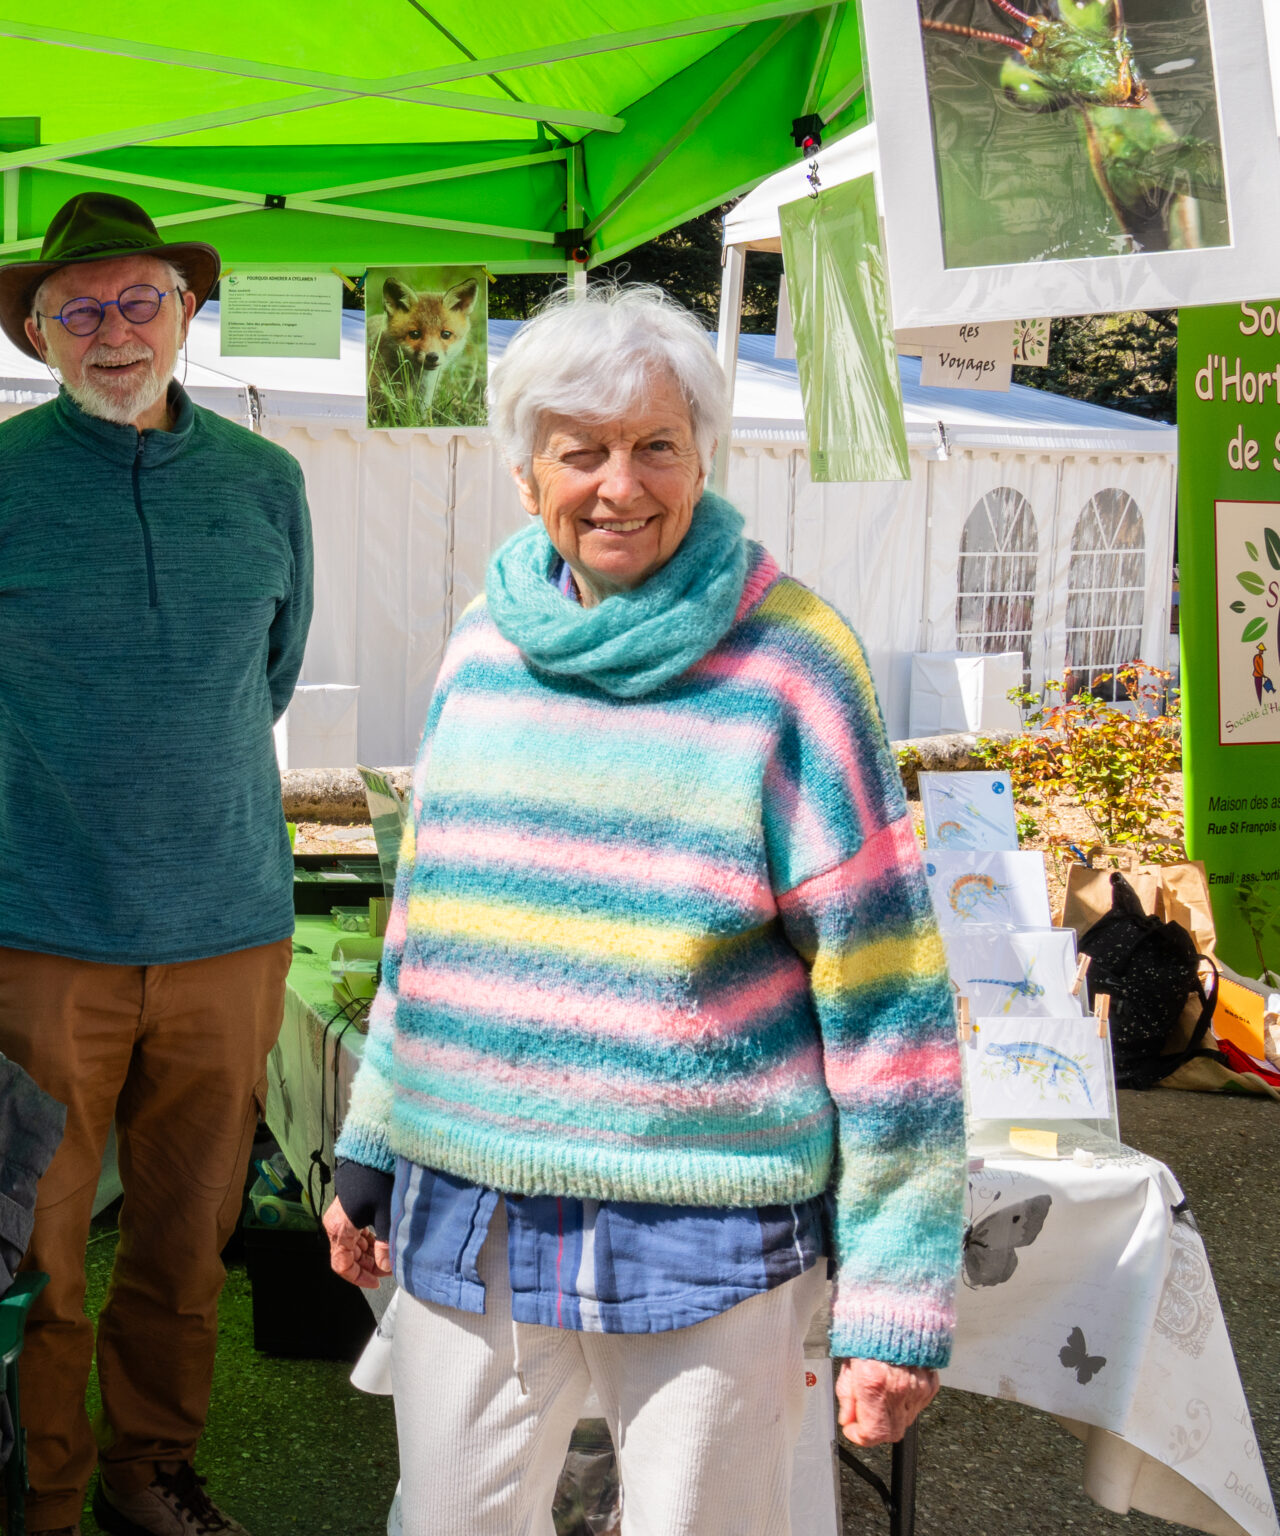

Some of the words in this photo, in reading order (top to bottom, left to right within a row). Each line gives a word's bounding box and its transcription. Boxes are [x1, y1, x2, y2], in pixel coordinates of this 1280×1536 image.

[1239, 300, 1280, 336] So
[959, 324, 980, 343] des
[938, 352, 996, 381] Voyages
[1227, 424, 1261, 471] de
[1225, 708, 1260, 733] Société
[1262, 702, 1280, 716] d'H
[1208, 796, 1248, 811] Maison
[1250, 795, 1269, 809] des
[1208, 823, 1227, 834] Rue
[1230, 822, 1239, 834] St
[1241, 820, 1277, 836] François
[1209, 871, 1235, 885] Email
